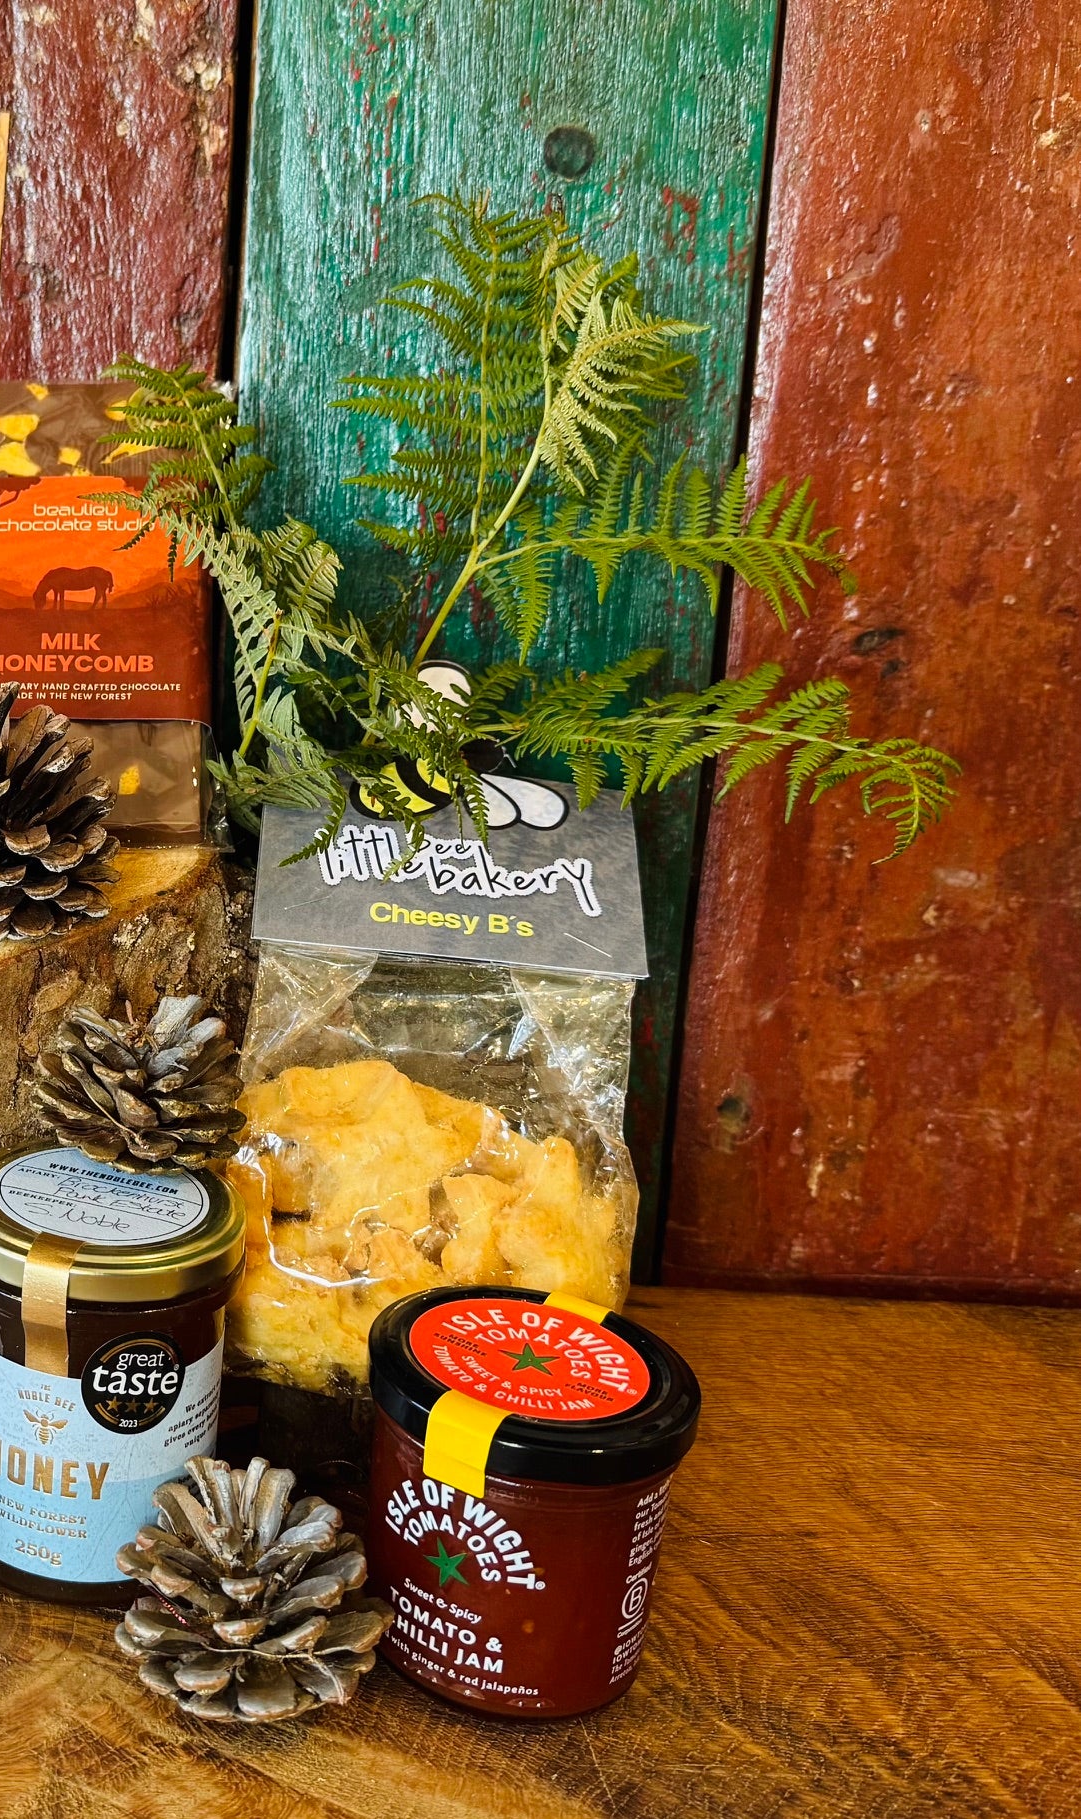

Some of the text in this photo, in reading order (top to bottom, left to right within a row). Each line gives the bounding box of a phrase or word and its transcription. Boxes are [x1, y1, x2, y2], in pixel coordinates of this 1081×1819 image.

[33, 503, 119, 517] beaulieu
[40, 632, 101, 650] MILK
[41, 683, 70, 691] HAND
[73, 683, 117, 691] CRAFTED
[120, 683, 181, 691] CHOCOLATE
[71, 692, 132, 701] NEW FOREST
[318, 826, 424, 882] little
[426, 844, 599, 914] bakery
[369, 901, 480, 936] Cheesy
[59, 1208, 130, 1234] Noble
[442, 1308, 563, 1335] ISLE OF
[116, 1352, 165, 1370] great
[474, 1328, 592, 1380] TOMATOES
[91, 1365, 179, 1396] taste
[432, 1344, 596, 1412] TOMATO CHILLI JAM
[461, 1355, 563, 1398] SWEET SPICY
[119, 1419, 138, 1428] 2023
[164, 1432, 185, 1447] gives
[30, 1506, 87, 1526] FOREST
[385, 1478, 536, 1591] ISLE OF WIGHT
[403, 1510, 502, 1584] TOMATOES
[15, 1538, 63, 1566] 250g
[403, 1577, 482, 1624] Sweet Spicy
[389, 1586, 503, 1653] TOMATO &
[392, 1614, 504, 1674] HILLI JAM
[410, 1651, 539, 1696] ginger red jalapeños
